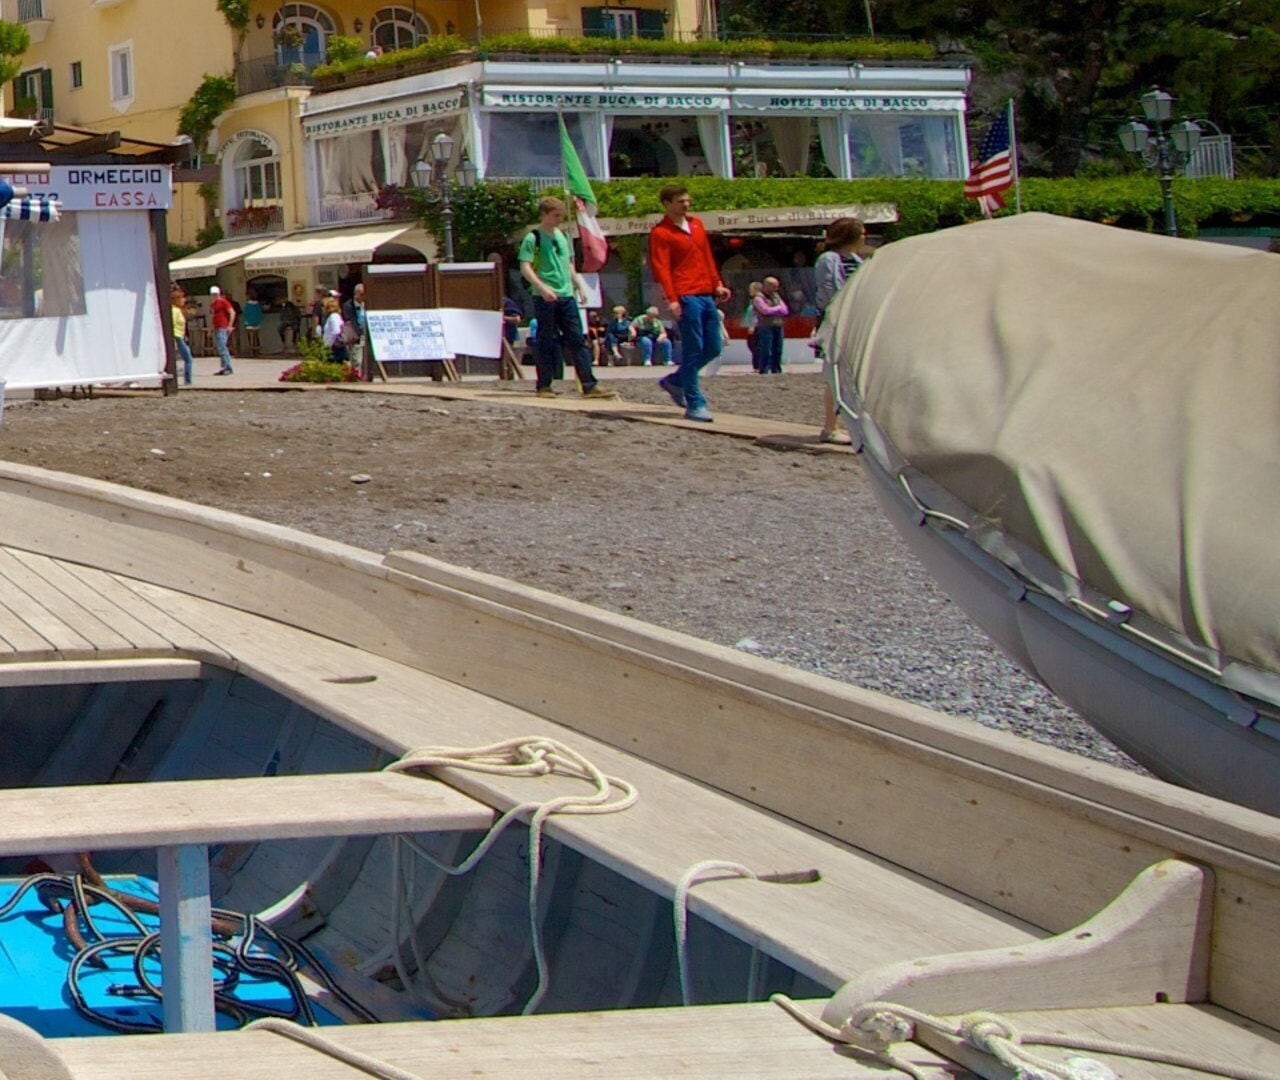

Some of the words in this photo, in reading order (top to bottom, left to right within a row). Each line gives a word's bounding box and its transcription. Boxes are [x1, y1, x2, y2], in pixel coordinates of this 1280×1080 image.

[502, 94, 591, 104] RISTORANTE
[599, 96, 637, 105] BUCA
[644, 96, 659, 105] DI
[666, 96, 713, 106] BACCO
[770, 97, 814, 107] HOTEL
[820, 98, 856, 107] BUCA
[863, 98, 877, 107] DI
[883, 98, 928, 107] BACCO
[305, 114, 368, 134] RISTORANTE
[371, 110, 401, 122] BUCA
[406, 105, 418, 115] DI
[423, 98, 459, 113] BACCO
[68, 170, 161, 184] ORMEGGIO
[95, 192, 158, 207] CASSA
[718, 216, 738, 225] Bar
[748, 214, 780, 224] Buca
